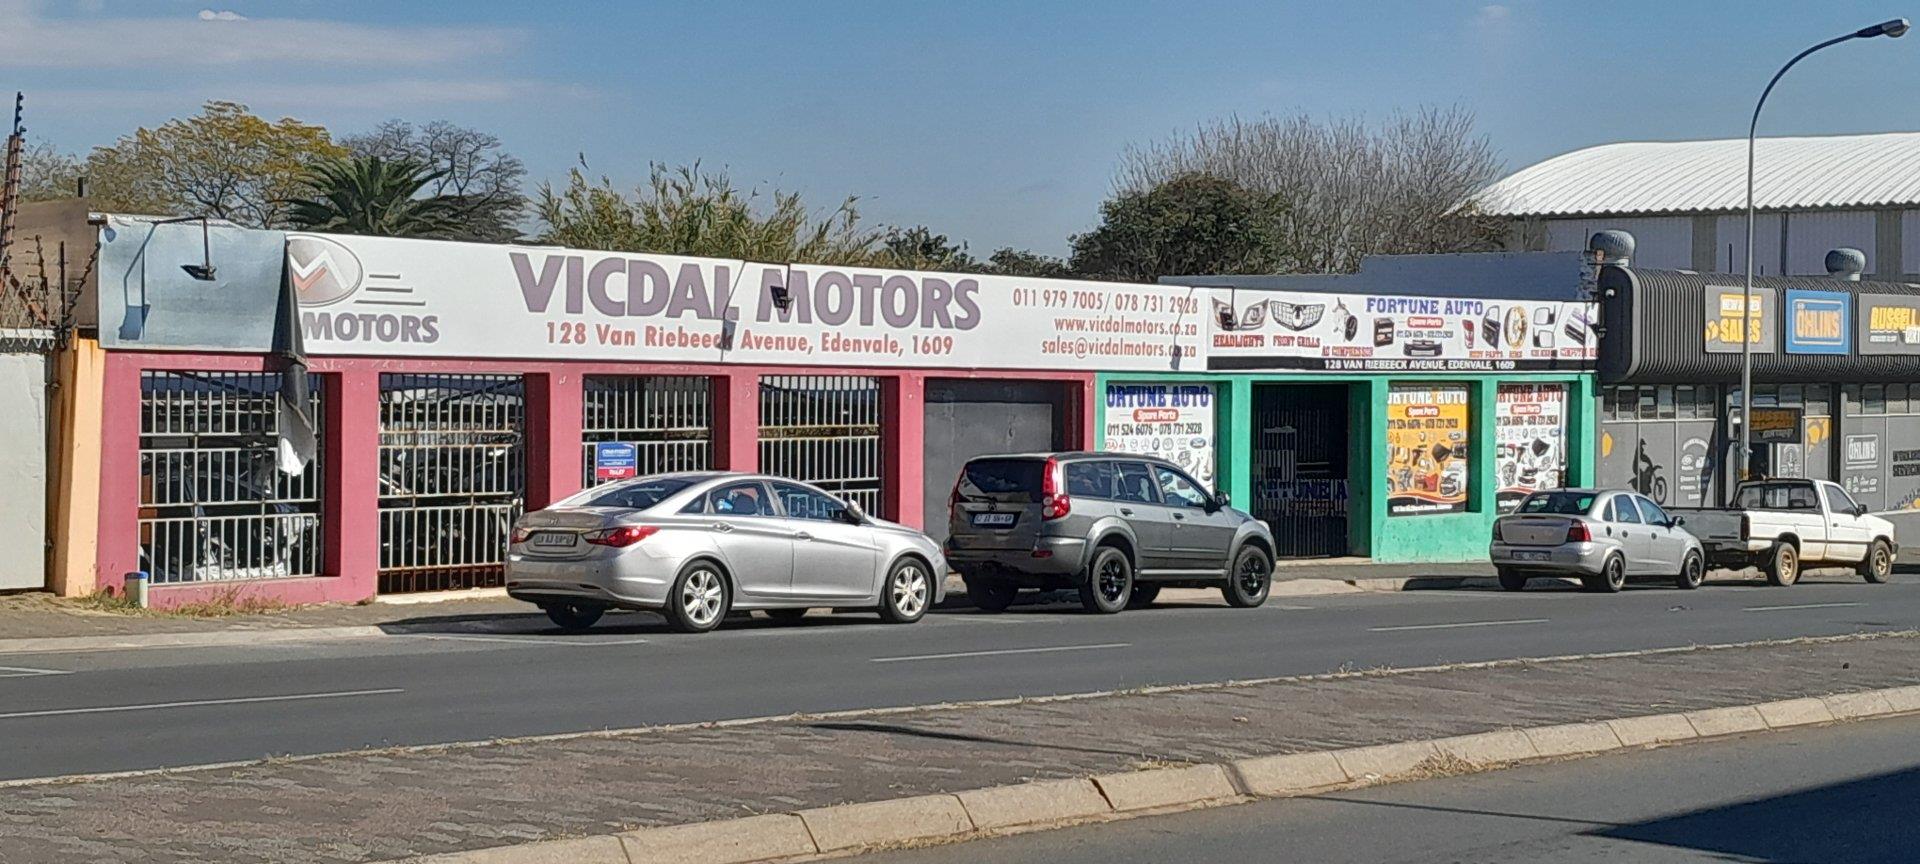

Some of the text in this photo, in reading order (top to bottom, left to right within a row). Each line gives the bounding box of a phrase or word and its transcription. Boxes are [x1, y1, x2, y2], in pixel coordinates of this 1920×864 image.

[509, 252, 982, 331] VICDAL MOTORS
[1013, 288, 1037, 307] 011
[1043, 290, 1067, 308] 979
[1115, 293, 1139, 312] 078
[1143, 295, 1164, 312] 731
[1169, 296, 1198, 314] 2928
[1366, 297, 1484, 316] FORTUNE AUTO
[302, 312, 440, 344] MOTORS
[1054, 315, 1197, 336] www.vicdalmotors.co.za
[547, 321, 587, 345] 128
[595, 323, 636, 347] Van
[741, 328, 814, 355] Avenue,
[821, 331, 904, 357] Edenvale,
[912, 335, 954, 355] 1609
[1213, 335, 1265, 348] HEADLIGHTS
[1325, 360, 1341, 370] 128
[1343, 360, 1363, 370] VAN
[1365, 360, 1408, 370] RIEBEECK
[1495, 361, 1516, 370] 1609
[1106, 385, 1209, 408] ORTUNE AUTO
[1137, 411, 1177, 423] Spare Parts
[1107, 423, 1120, 436] 011
[1121, 423, 1134, 436] 524
[1173, 423, 1185, 435] 731
